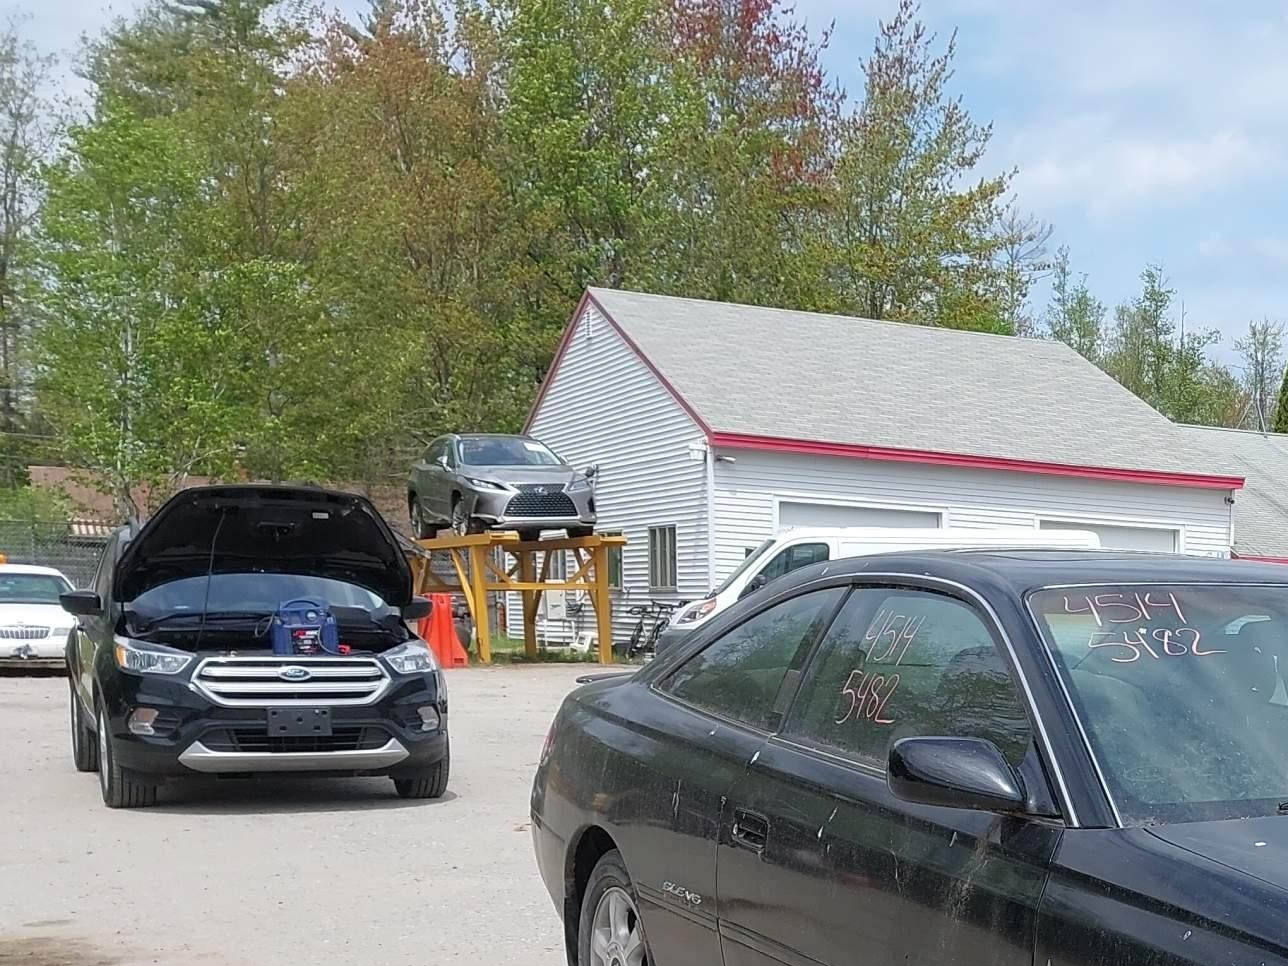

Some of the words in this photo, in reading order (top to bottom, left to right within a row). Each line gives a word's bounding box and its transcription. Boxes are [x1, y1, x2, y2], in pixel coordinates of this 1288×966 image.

[1063, 592, 1188, 627] 4514
[865, 609, 921, 667] 4514
[1087, 627, 1229, 663] 5482
[835, 669, 900, 724] 5482
